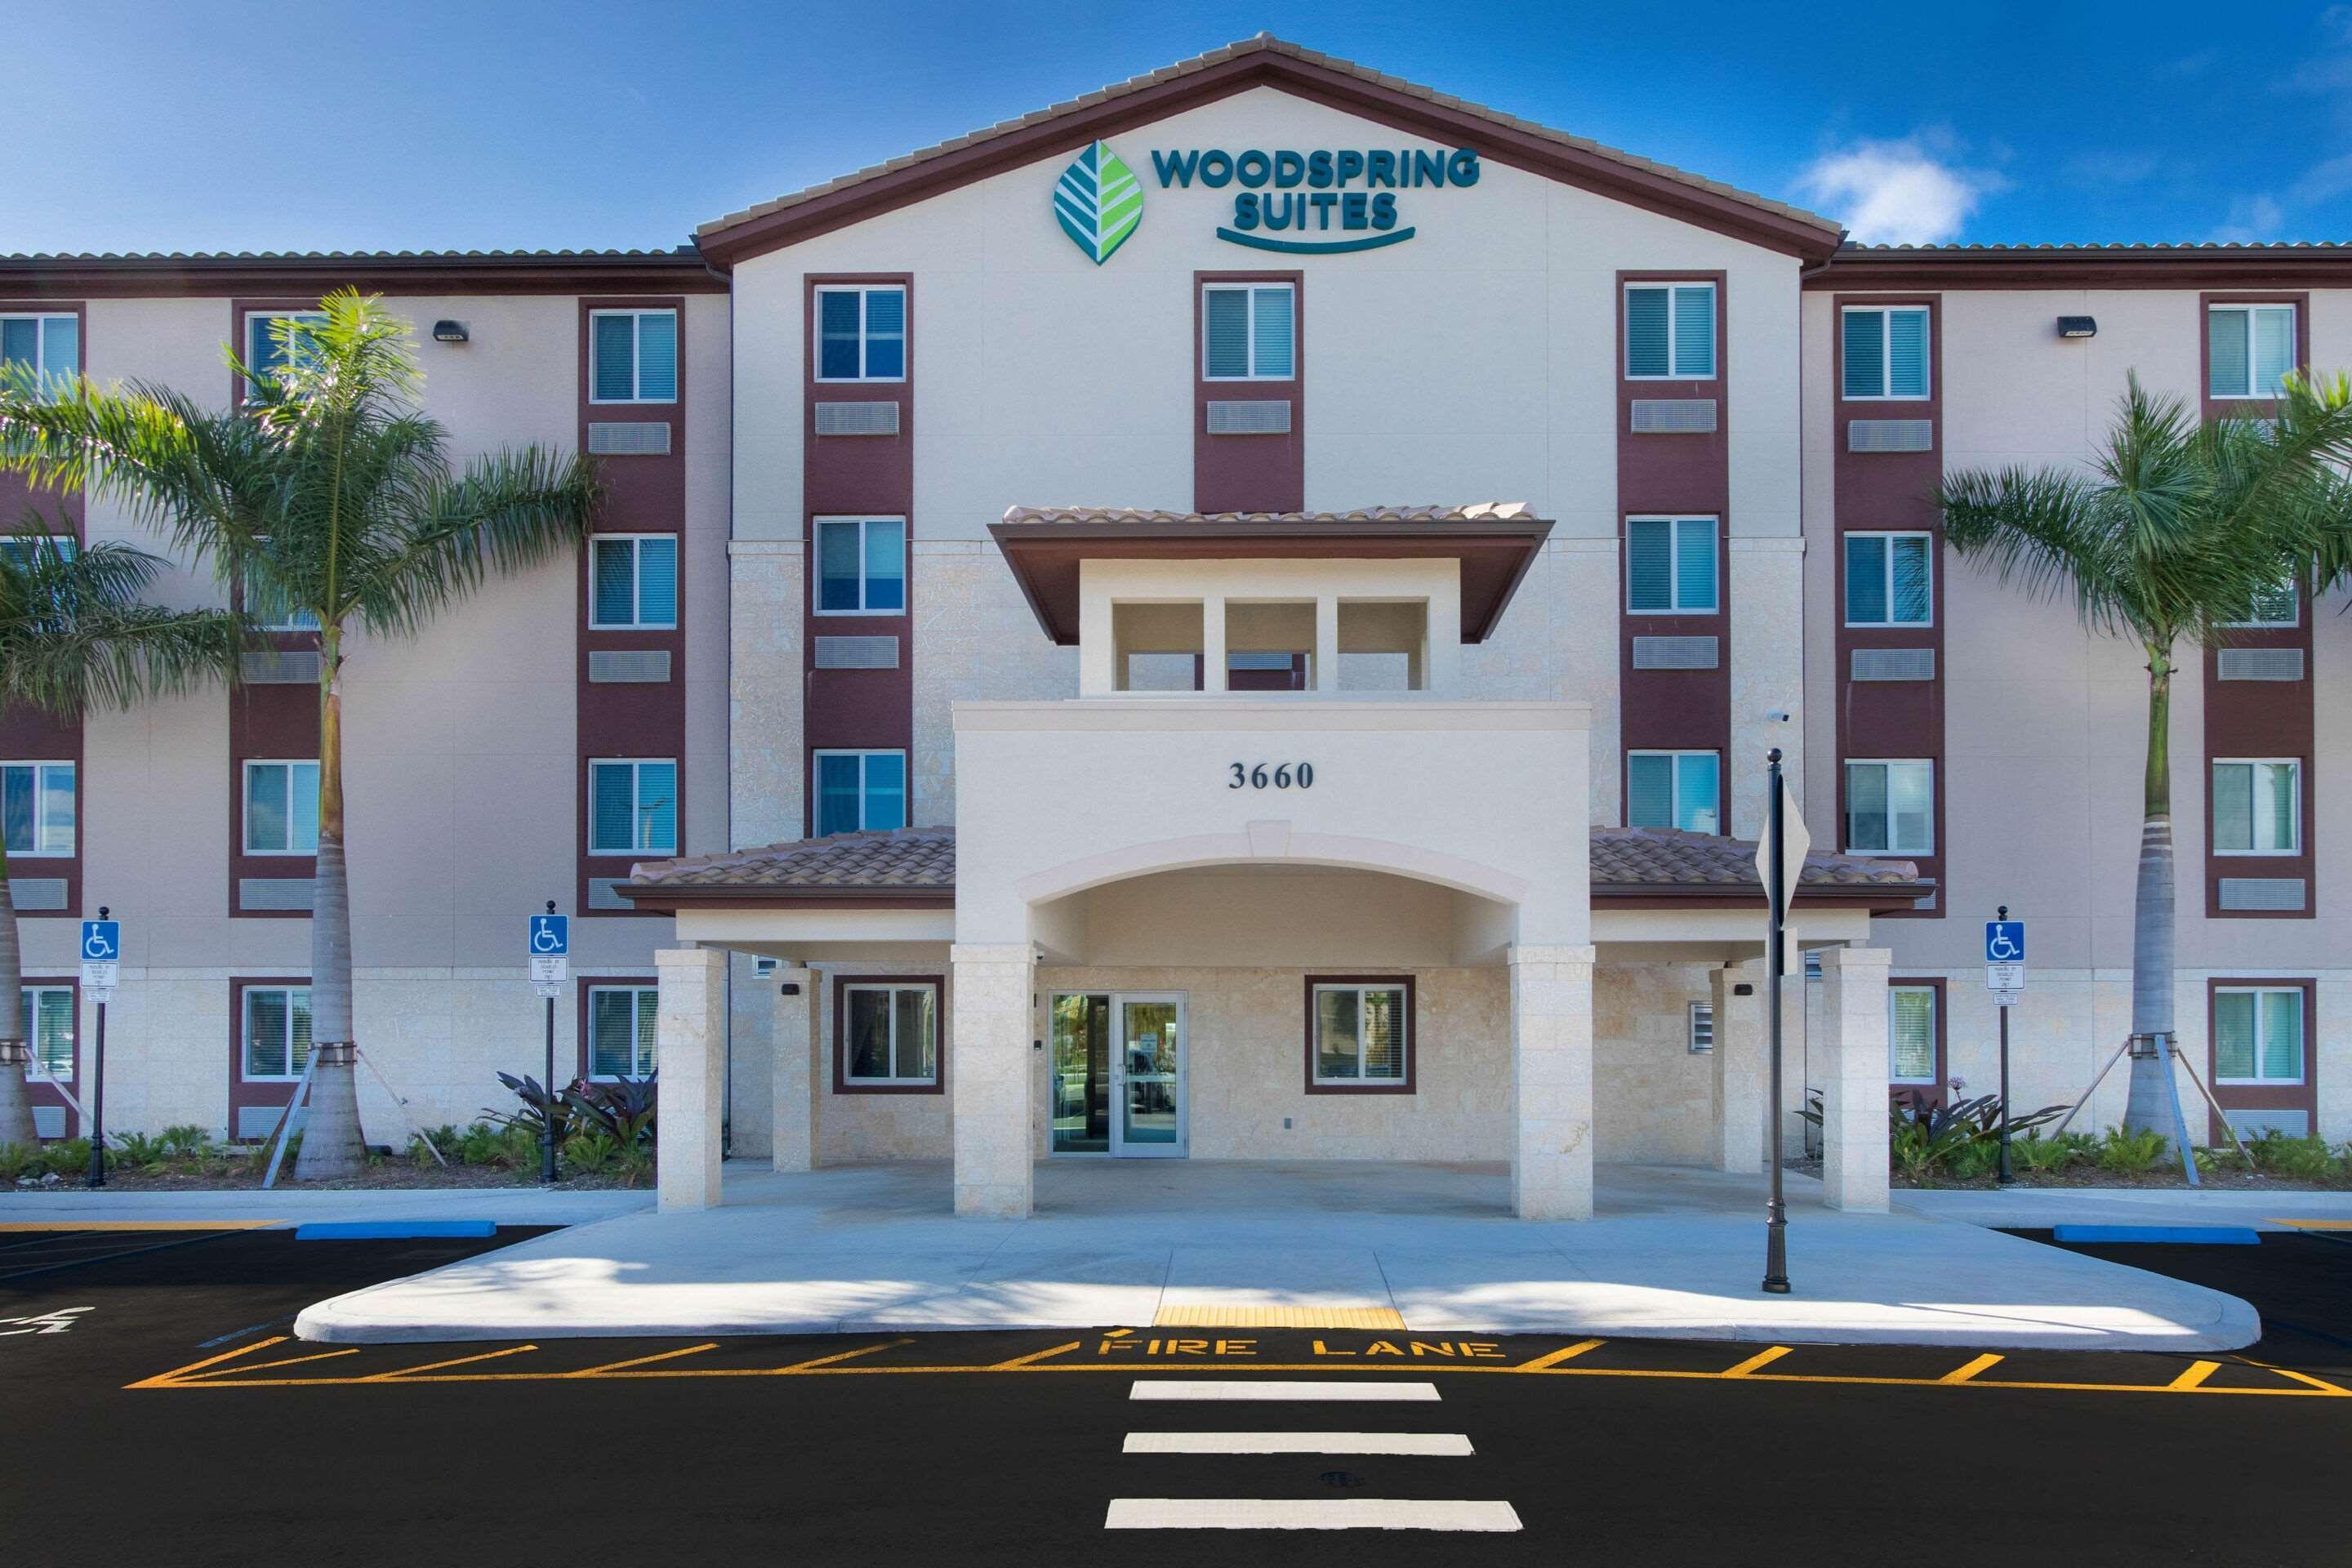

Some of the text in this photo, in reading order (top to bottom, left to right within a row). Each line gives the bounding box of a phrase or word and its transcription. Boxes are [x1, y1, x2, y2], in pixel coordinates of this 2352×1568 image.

[1151, 149, 1480, 188] WOODSPRING
[1234, 193, 1397, 230] SUITES
[1229, 762, 1313, 789] 3660
[1098, 1339, 1506, 1358] FIRE LANE
